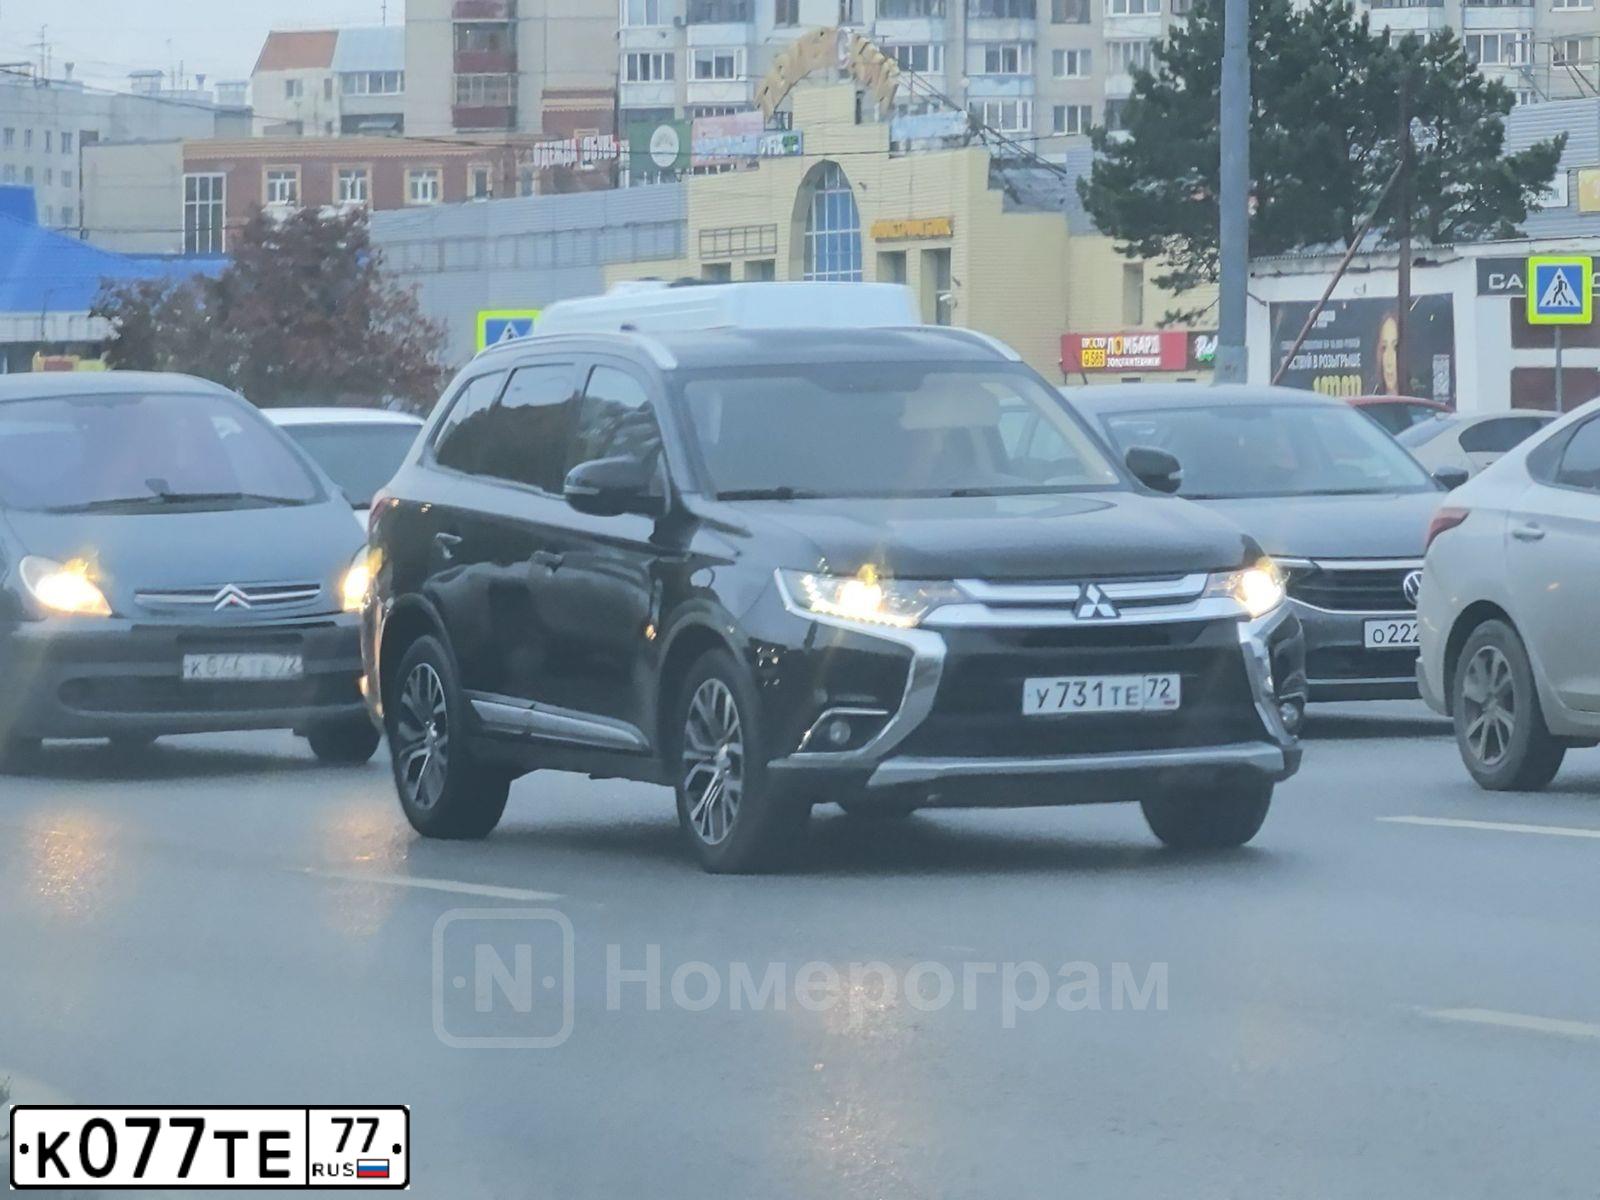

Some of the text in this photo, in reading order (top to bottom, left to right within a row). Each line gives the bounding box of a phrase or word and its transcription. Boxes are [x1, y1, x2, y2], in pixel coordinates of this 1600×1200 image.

[1107, 335, 1160, 355] ЛОМБАРД
[1319, 352, 1361, 369] РОЗЫГРЫШЕ
[1147, 678, 1171, 698] 72
